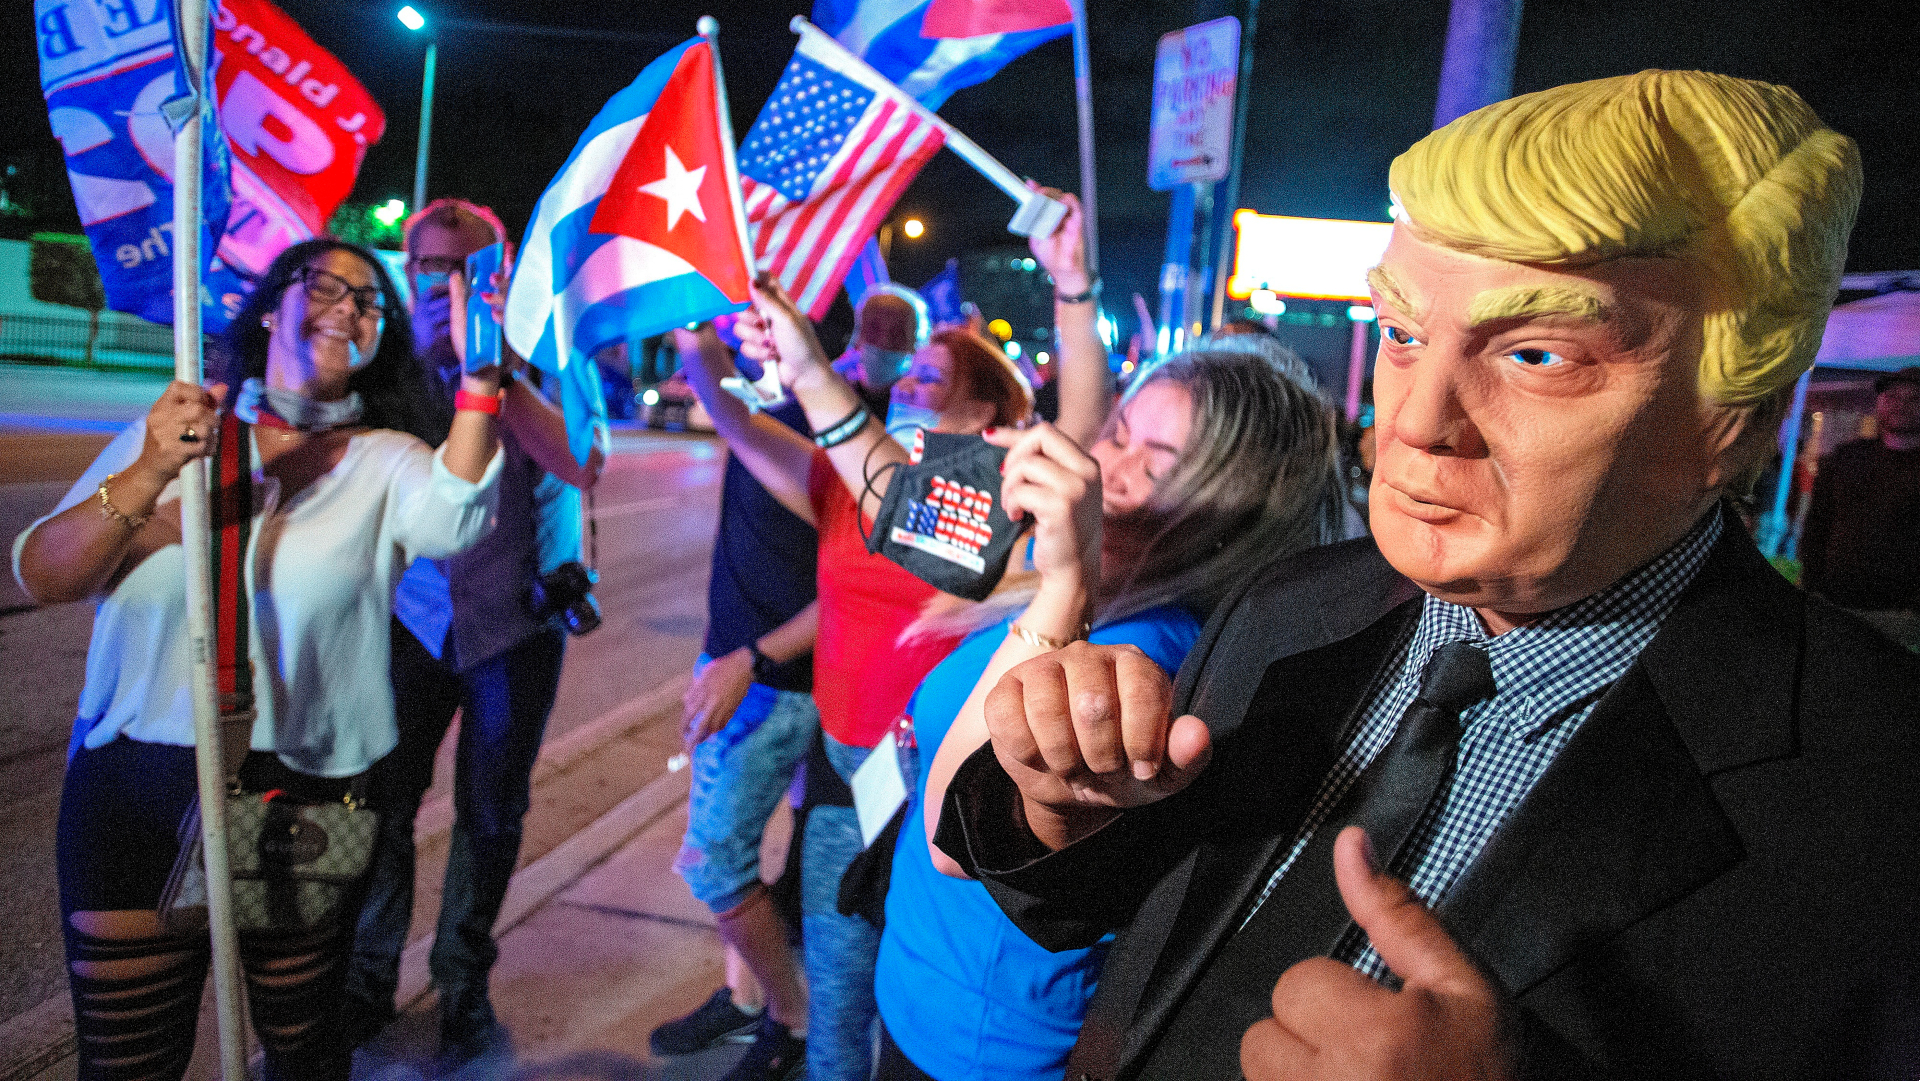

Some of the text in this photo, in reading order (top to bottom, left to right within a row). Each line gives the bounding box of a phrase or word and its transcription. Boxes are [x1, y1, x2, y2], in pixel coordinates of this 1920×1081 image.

[213, 4, 339, 107] onald
[1180, 35, 1212, 69] NO
[926, 475, 993, 522] 2020
[905, 498, 993, 555] TRUMP
